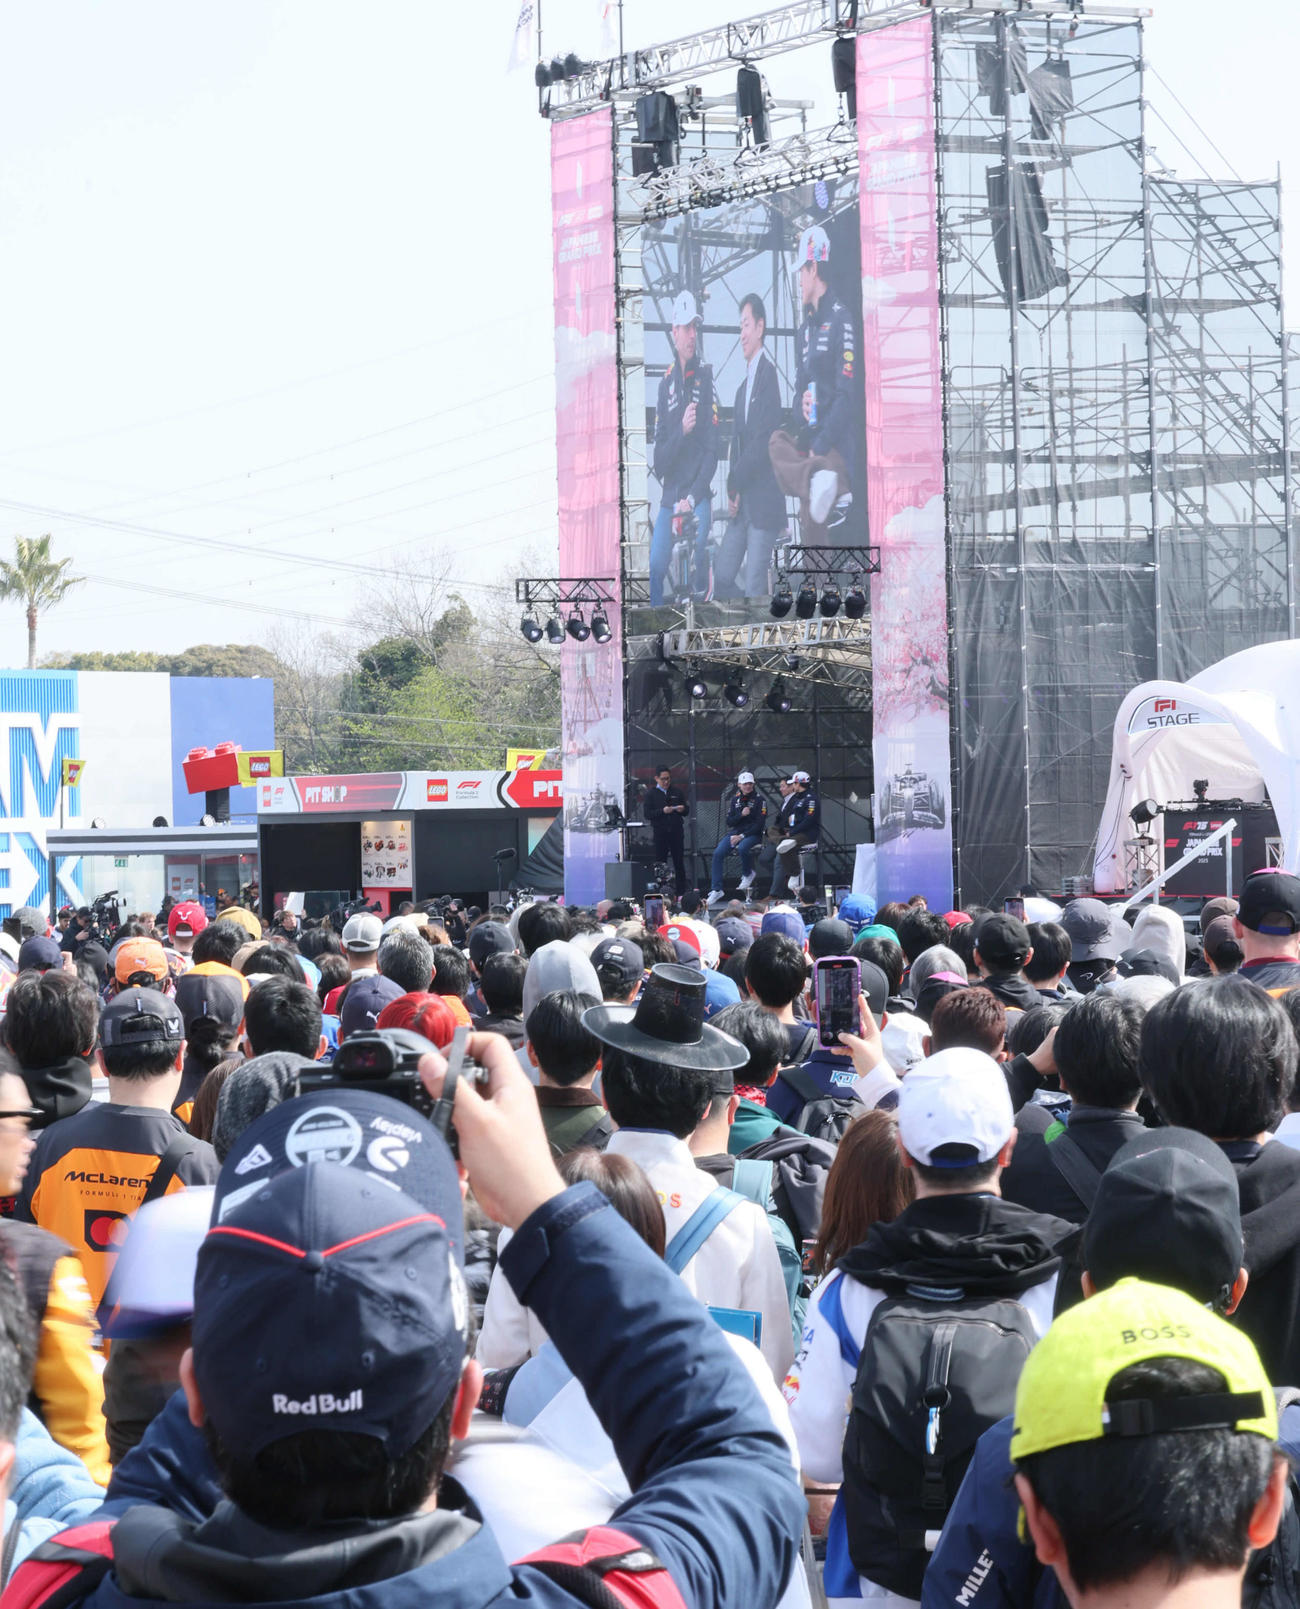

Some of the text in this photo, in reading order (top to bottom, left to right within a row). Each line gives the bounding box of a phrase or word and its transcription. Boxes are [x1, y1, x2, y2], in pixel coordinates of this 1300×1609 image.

[1147, 713, 1201, 729] STAGE
[0, 712, 83, 820] M
[250, 762, 270, 772] LEGO
[305, 787, 321, 803] PIT
[428, 785, 447, 796] LEGO
[64, 1170, 151, 1188] McLaren
[1121, 1325, 1192, 1345] BOSS
[272, 1388, 363, 1415] Red Bull
